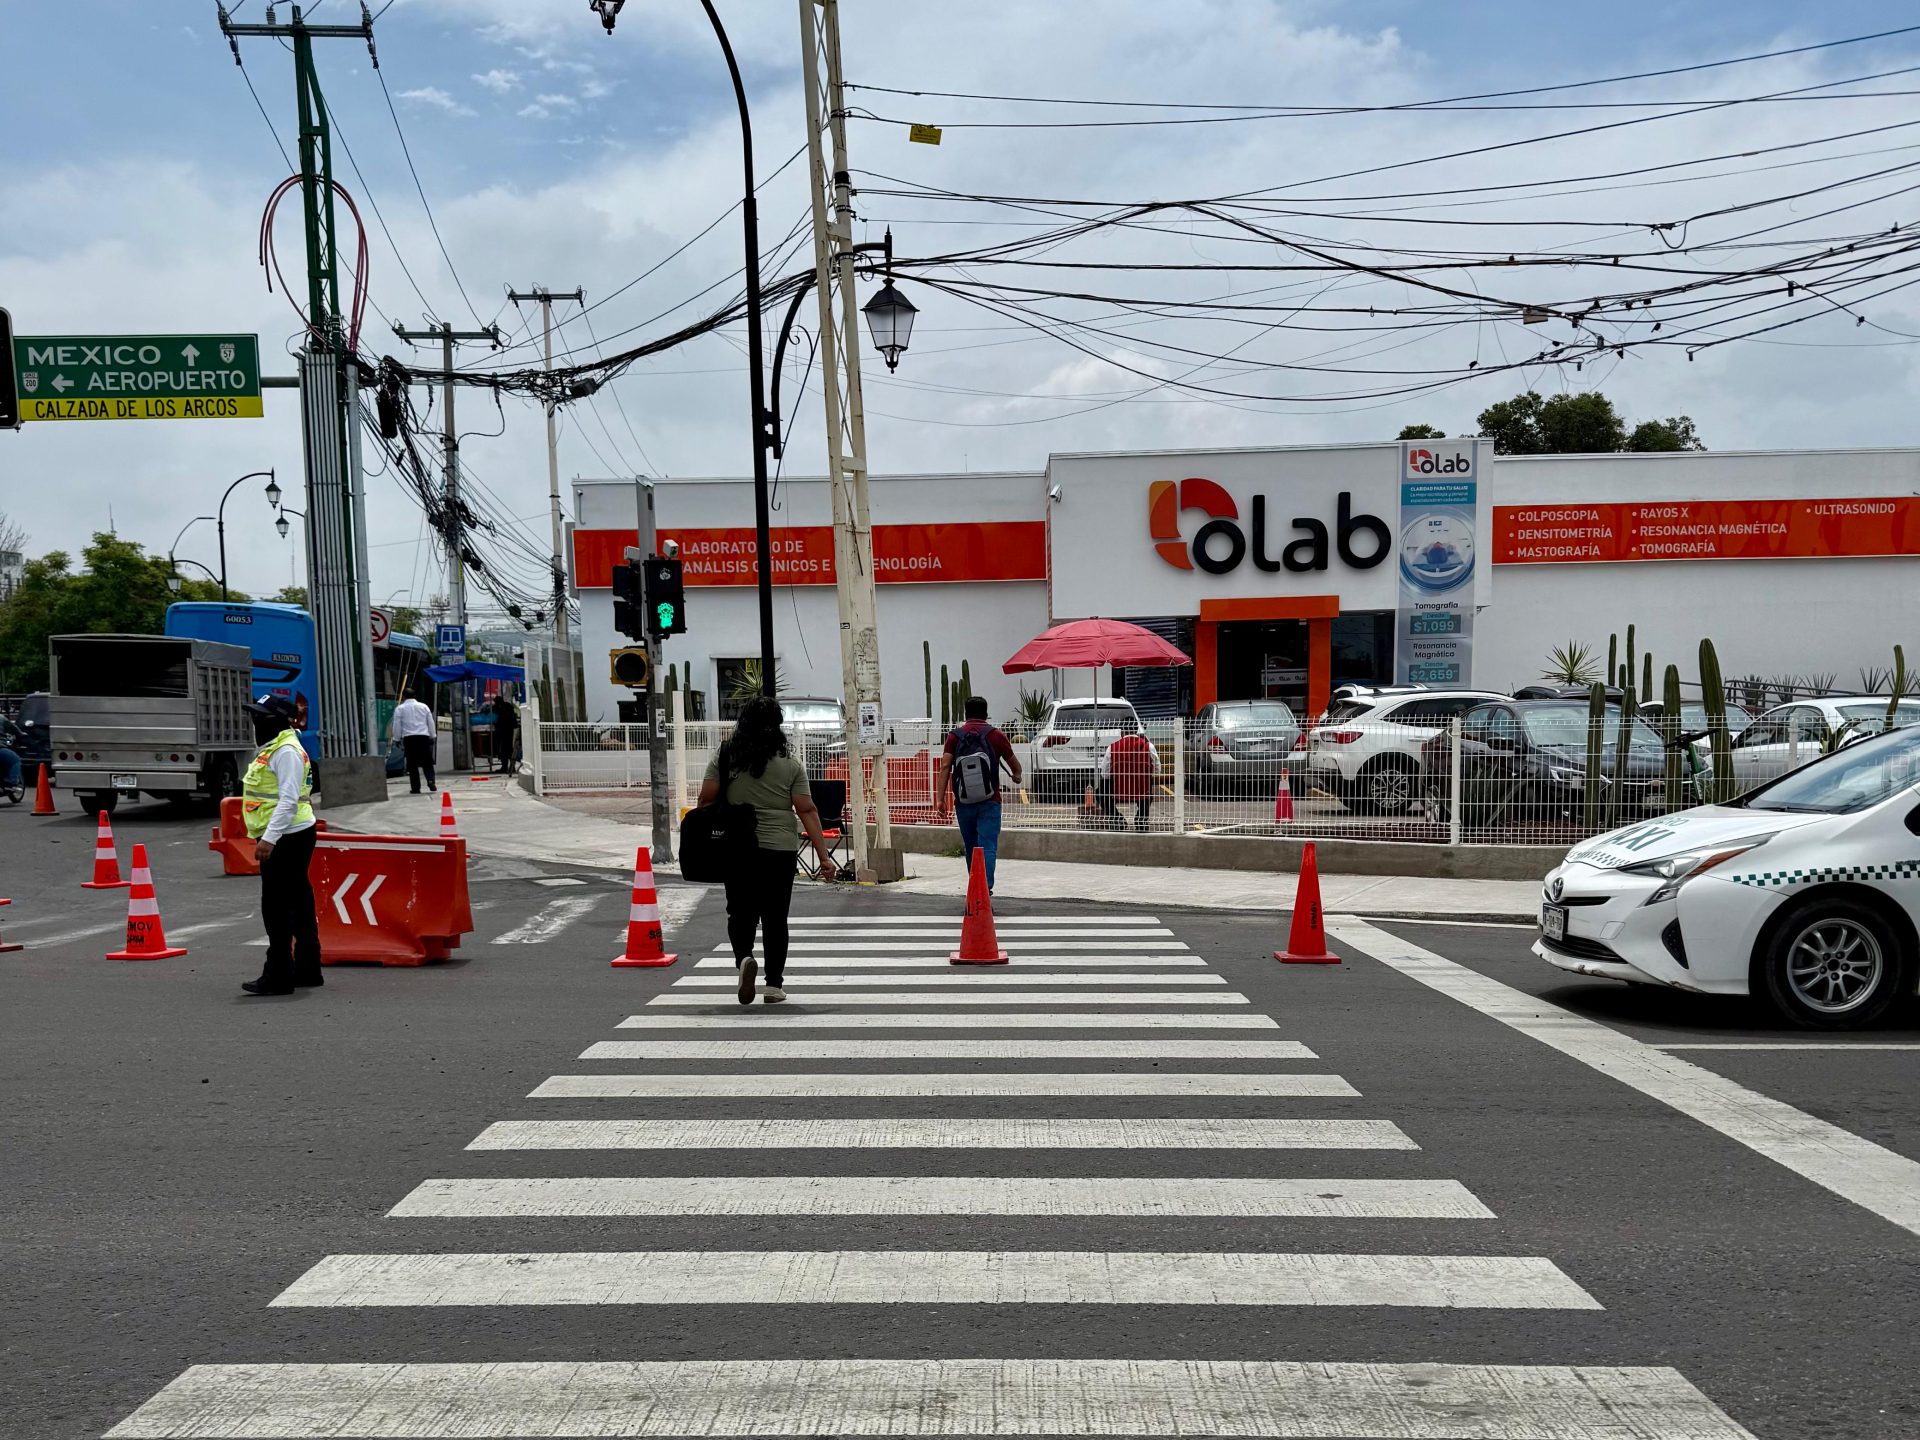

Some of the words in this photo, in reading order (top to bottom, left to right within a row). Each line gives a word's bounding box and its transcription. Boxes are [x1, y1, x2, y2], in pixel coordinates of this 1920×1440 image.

[27, 345, 162, 366] MEXICO
[223, 350, 232, 358] 57
[25, 379, 37, 387] 200
[87, 369, 246, 391] AEROPUERTO
[35, 400, 109, 418] CALZADA
[117, 401, 137, 417] DE
[145, 400, 176, 416] LOS
[183, 399, 238, 416] ARCOS
[1518, 510, 1599, 522] COLPOSCOPIA
[1640, 508, 1679, 519] RAYOS
[1681, 507, 1689, 517] X
[1814, 503, 1896, 515] ULTRASONIDO
[1517, 525, 1613, 540] DENSITOMETRÍA
[1640, 524, 1716, 536] RESONANCIA
[1718, 521, 1787, 535] MAGNÉTICA
[682, 541, 781, 555] LABORATOO
[785, 541, 804, 552] DE
[1517, 543, 1601, 558] MASTOGRAFÍA
[1640, 540, 1716, 554] TOMOGRAFÍA
[683, 557, 749, 573] ANÁLISIS
[822, 559, 831, 571] E
[226, 615, 251, 624] 60053
[1413, 621, 1454, 632] $1,099
[1410, 668, 1454, 681] $2,659
